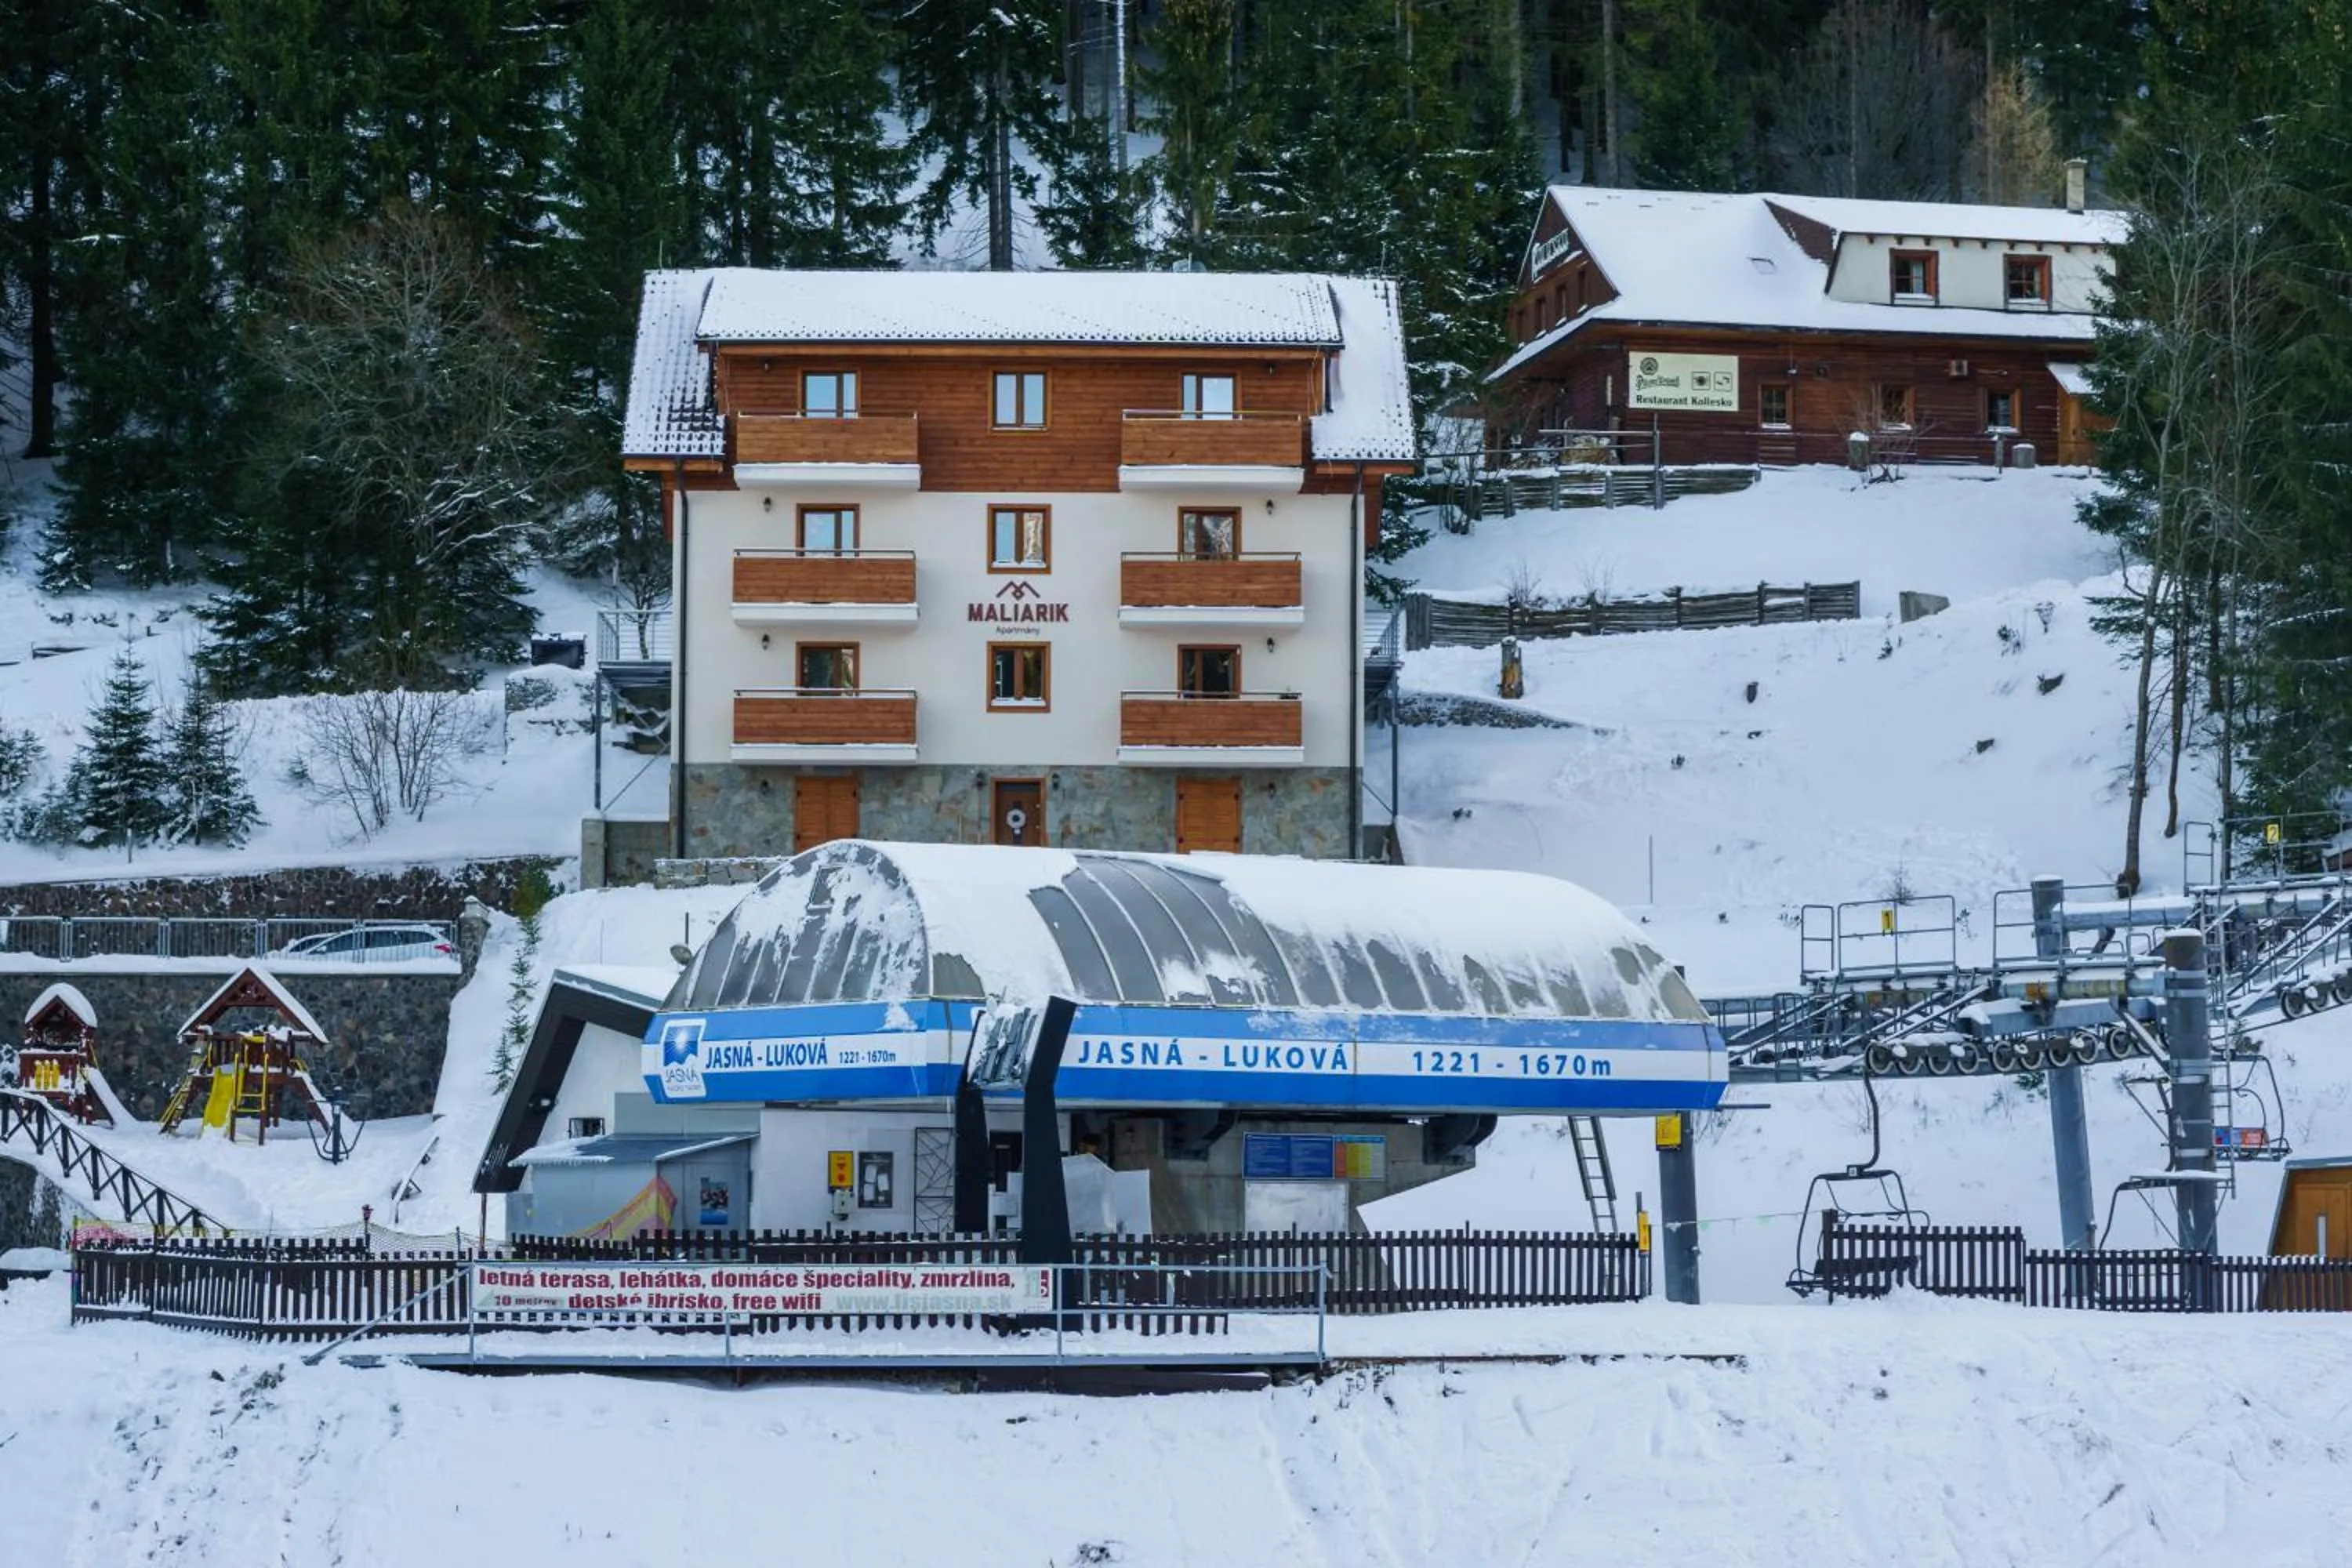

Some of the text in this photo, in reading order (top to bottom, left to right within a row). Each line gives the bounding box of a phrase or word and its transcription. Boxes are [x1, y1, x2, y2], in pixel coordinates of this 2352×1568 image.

[1636, 394, 1688, 405] Restaurant
[967, 603, 1069, 622] MALIARIK
[706, 1041, 753, 1069] JASNÁ
[765, 1037, 827, 1066] LUKOVÁ
[839, 1051, 859, 1064] 1221
[867, 1049, 896, 1063] 1670m
[1078, 1039, 1183, 1065] JASNÁ
[1224, 1044, 1348, 1071] LUKOVÁ
[1412, 1051, 1480, 1073] 1221
[1519, 1054, 1611, 1076] 1670m
[666, 1066, 700, 1083] JASNÁ
[479, 1267, 535, 1288] letná
[540, 1271, 615, 1290] terasa,
[711, 1269, 798, 1289] domáce
[568, 1293, 643, 1309] detské
[732, 1293, 777, 1311] free
[782, 1293, 822, 1310] wifi
